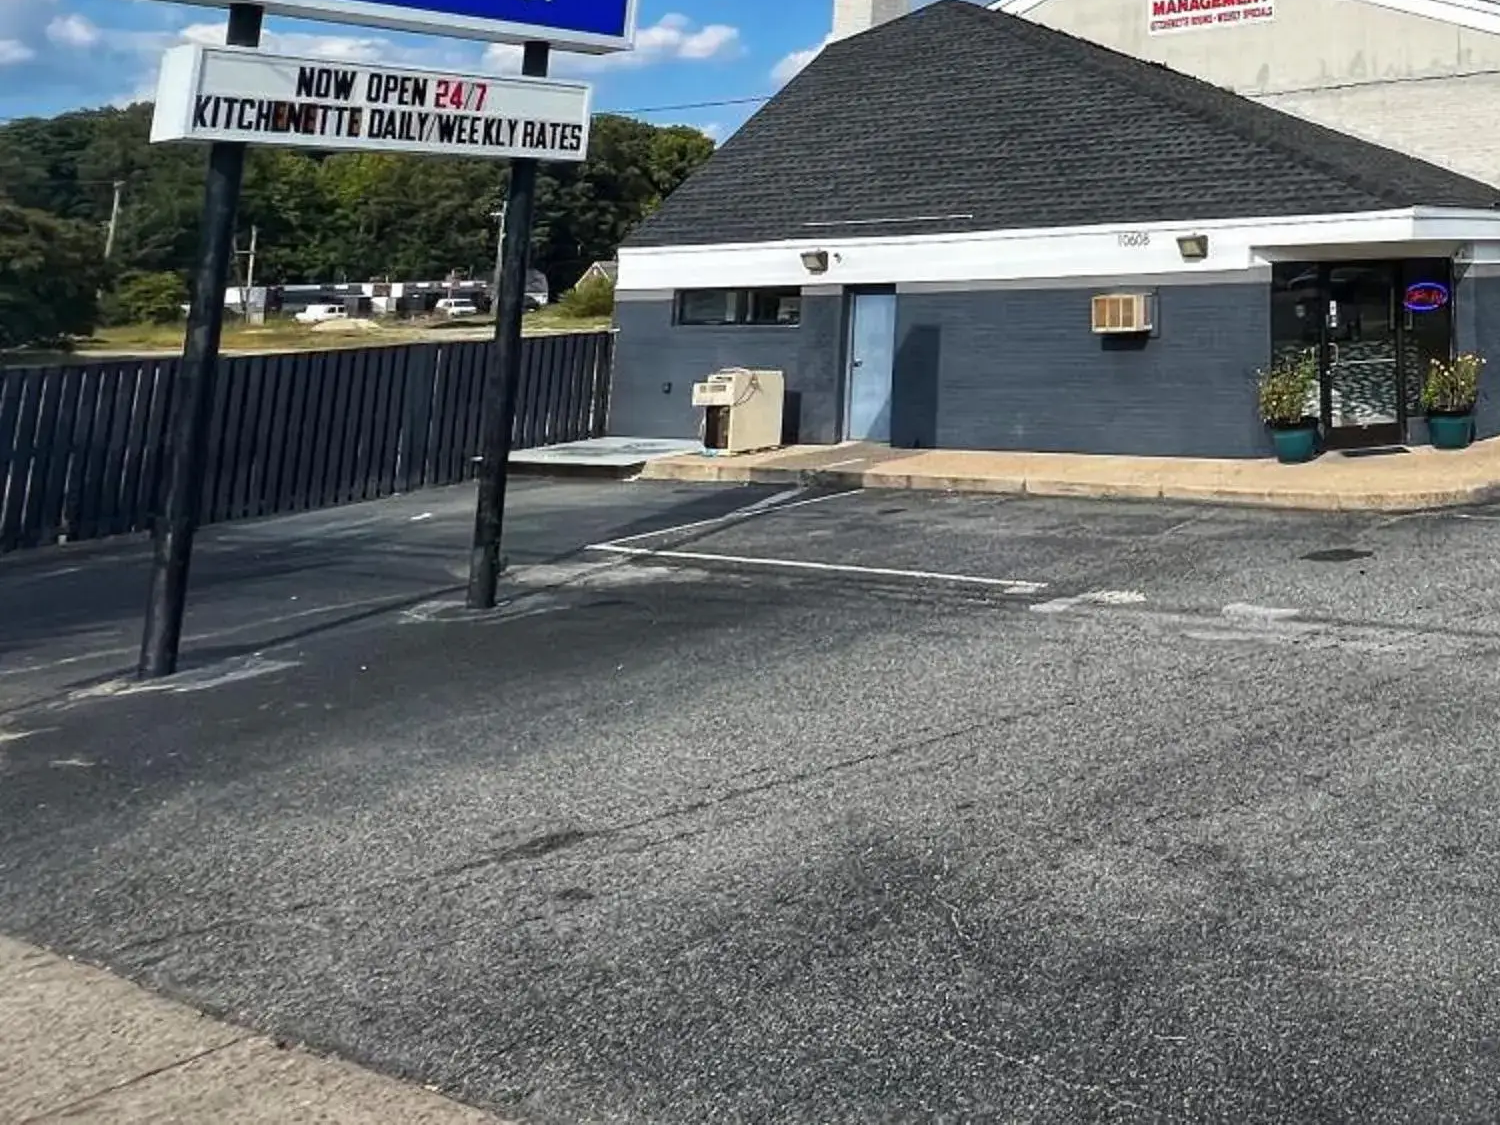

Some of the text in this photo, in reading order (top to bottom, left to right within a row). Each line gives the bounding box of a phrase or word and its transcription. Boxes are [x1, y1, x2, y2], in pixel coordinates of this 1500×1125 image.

[296, 66, 487, 111] NOW OPEN 24/7
[193, 94, 363, 137] KITCHENETTE
[521, 118, 583, 152] RATES
